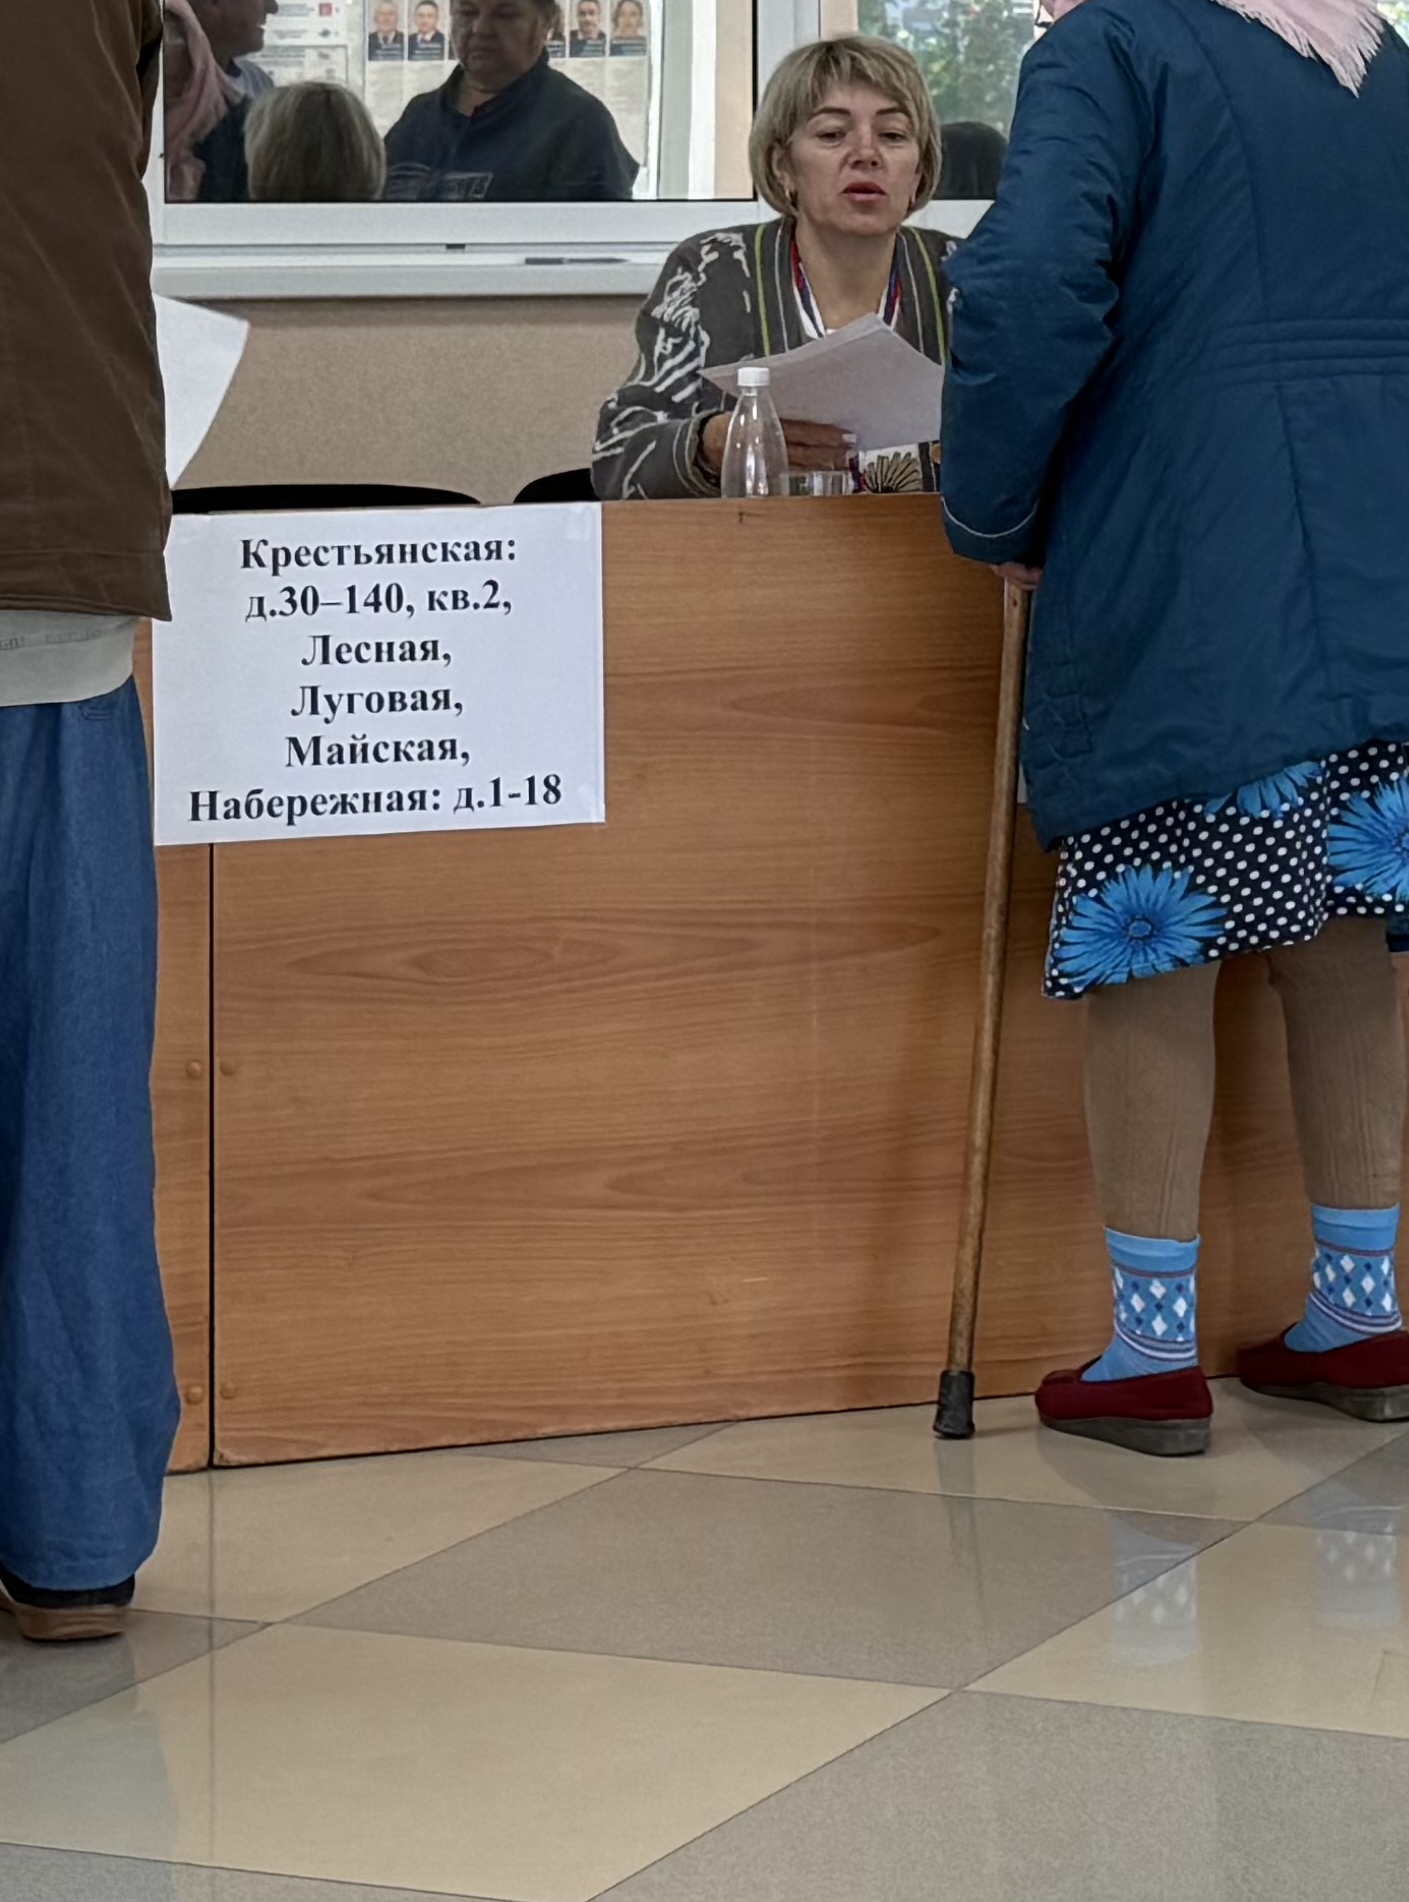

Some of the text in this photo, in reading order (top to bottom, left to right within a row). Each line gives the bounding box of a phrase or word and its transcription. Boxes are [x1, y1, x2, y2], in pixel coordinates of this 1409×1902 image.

[240, 538, 516, 577] Крестьянская:
[427, 579, 512, 615] кв.2,
[301, 634, 452, 667] Лесная,
[290, 685, 463, 725] Луговая,
[285, 733, 470, 768] Майская,
[190, 773, 562, 827] Набережная: д.1-18
